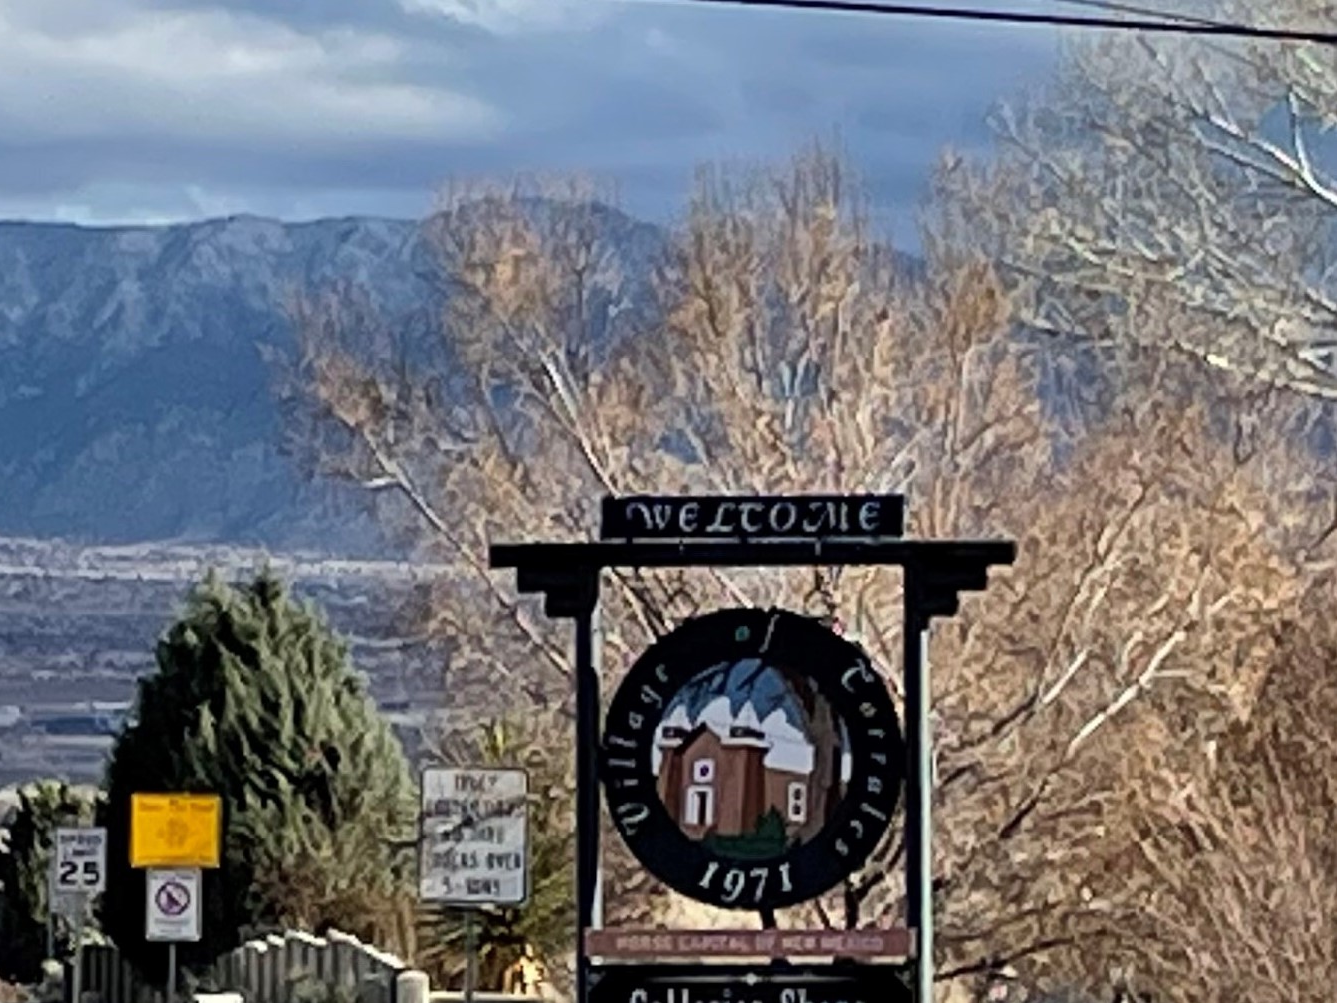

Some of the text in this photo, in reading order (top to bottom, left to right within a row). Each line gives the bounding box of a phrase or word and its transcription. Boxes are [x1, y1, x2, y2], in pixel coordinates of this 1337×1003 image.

[626, 502, 881, 532] WELCOME
[608, 664, 669, 836] Village
[834, 658, 888, 855] Corrales
[60, 861, 100, 886] 25
[698, 861, 793, 903] 1971
